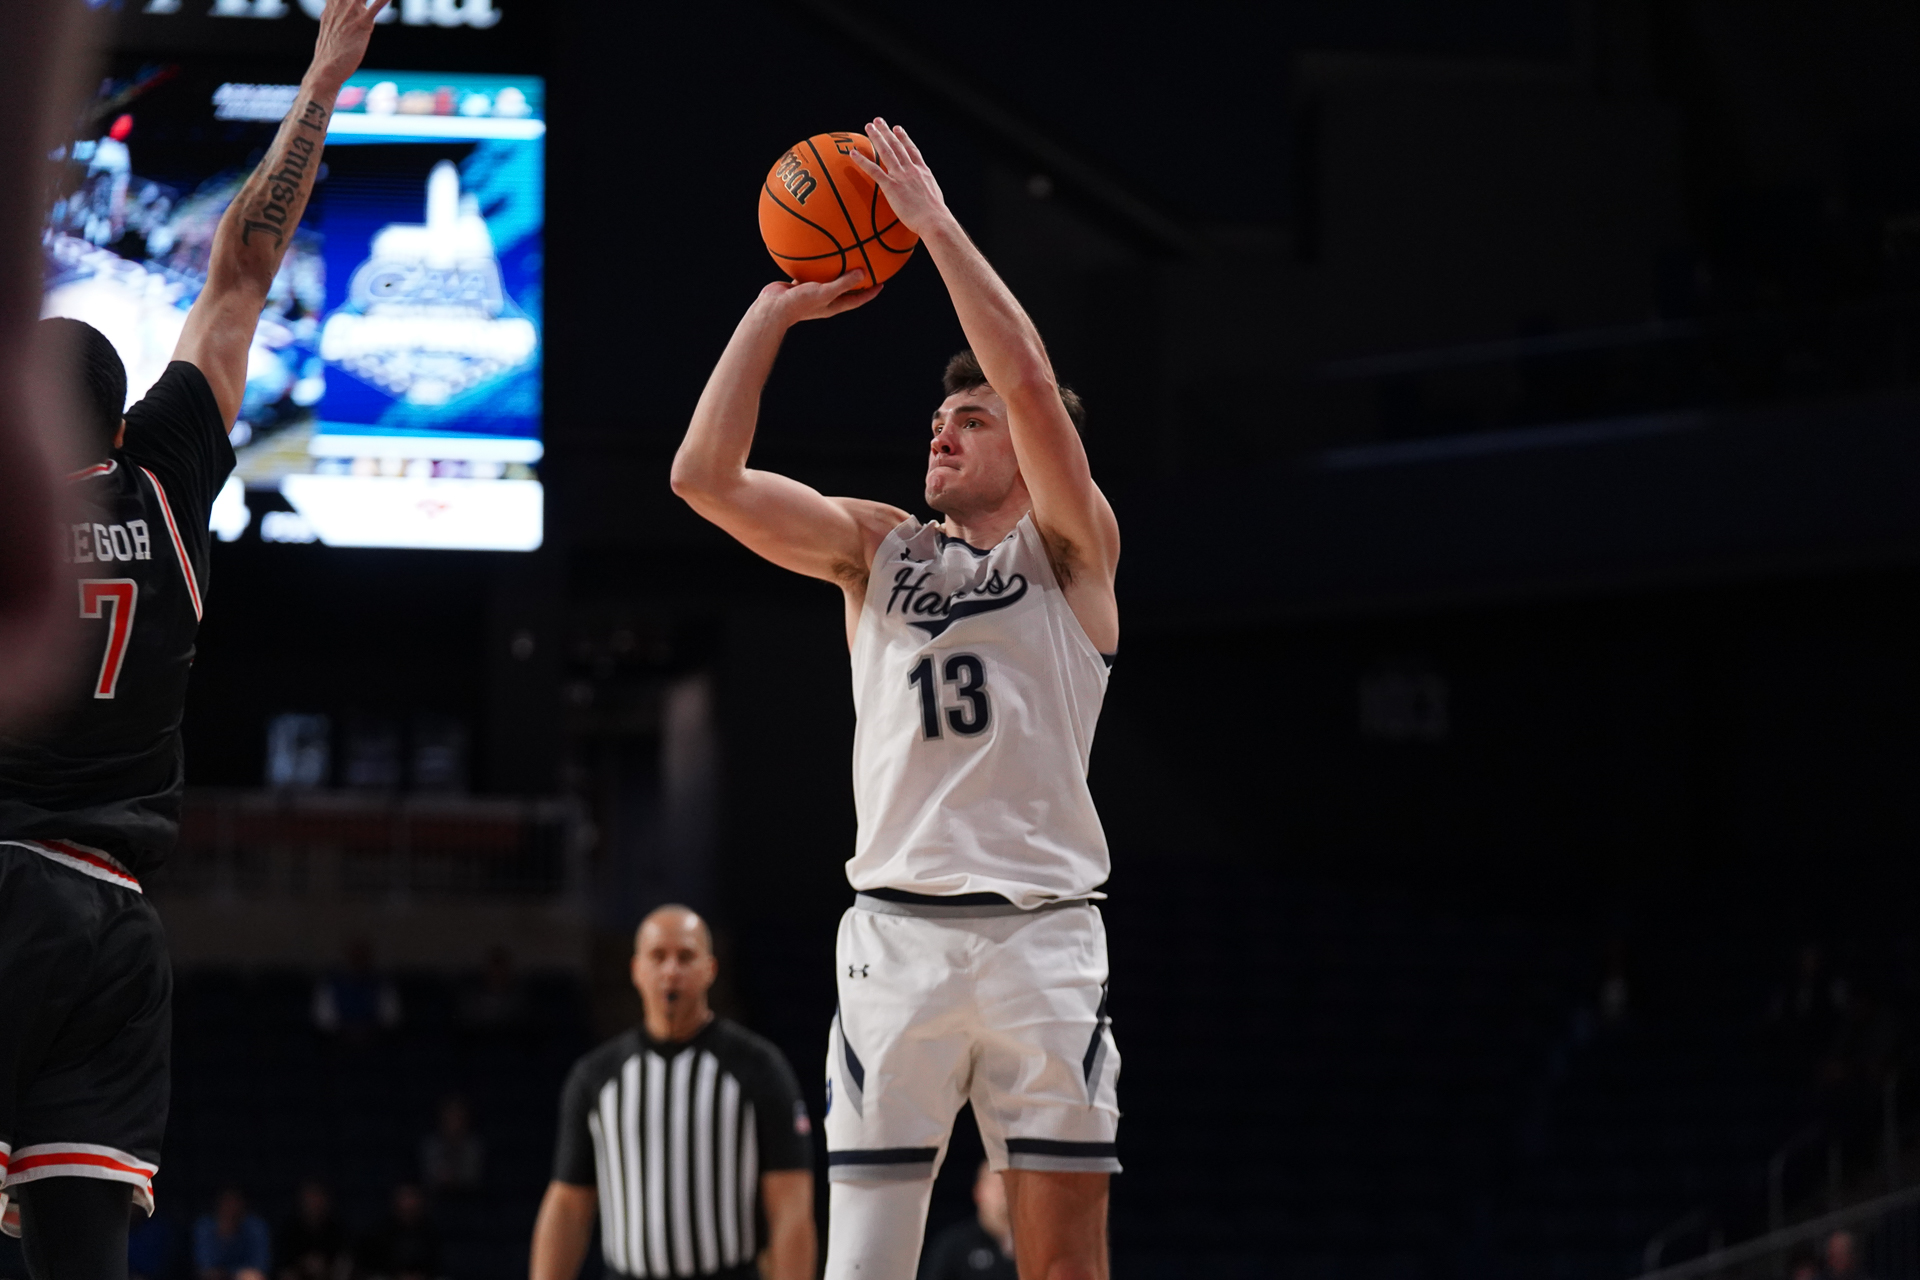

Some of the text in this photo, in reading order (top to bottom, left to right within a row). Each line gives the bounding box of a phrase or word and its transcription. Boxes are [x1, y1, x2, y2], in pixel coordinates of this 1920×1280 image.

[242, 136, 315, 250] Joshua
[298, 101, 327, 131] 1:9
[64, 519, 153, 563] EGOR
[78, 578, 139, 699] 7
[886, 566, 1028, 622] Has
[906, 652, 993, 741] 13
